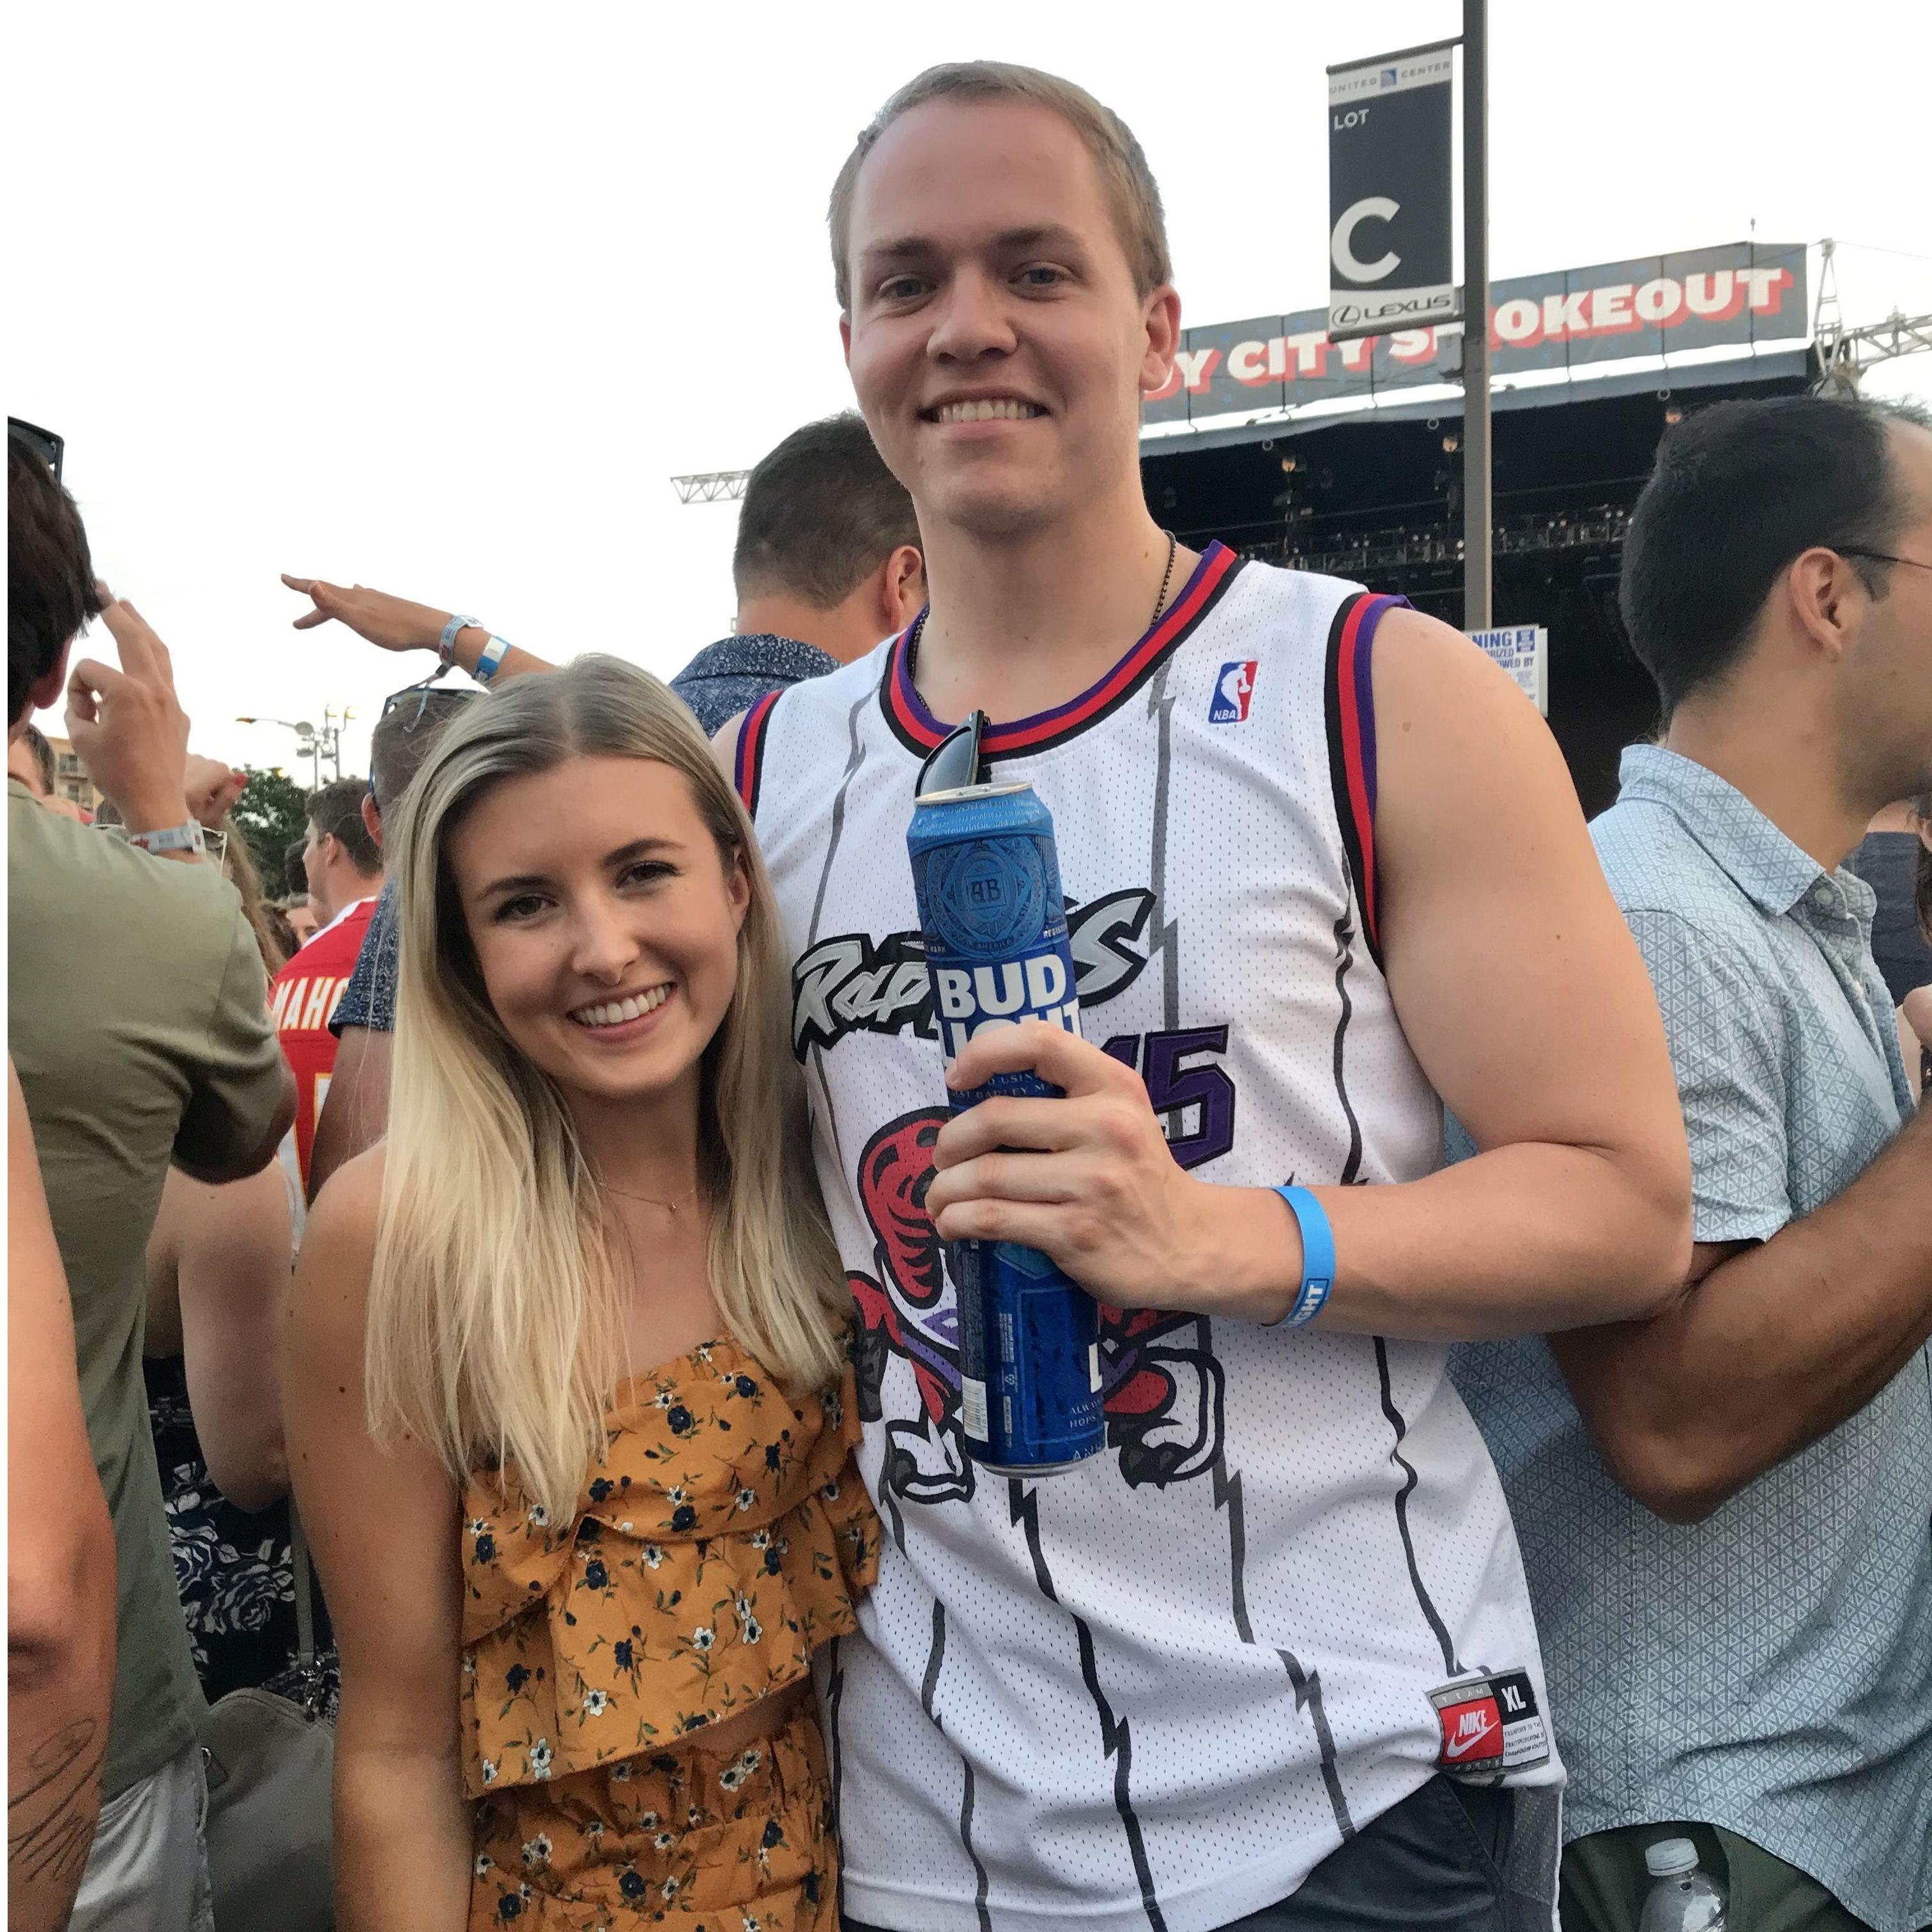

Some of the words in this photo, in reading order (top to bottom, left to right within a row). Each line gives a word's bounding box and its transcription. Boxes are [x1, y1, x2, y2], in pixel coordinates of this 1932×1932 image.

[1329, 77, 1377, 95] UNITED
[1401, 61, 1450, 79] CENTER
[1334, 109, 1369, 130] LOT
[1331, 196, 1402, 283] C
[1364, 294, 1451, 319] LEXUS
[1227, 329, 1366, 380] CITY
[1389, 268, 1782, 356] SOKEOUT
[1524, 657, 1534, 667] BY
[1213, 709, 1236, 721] NBA
[936, 954, 1067, 1019] BUD
[936, 998, 1084, 1070] LIT
[1501, 1685, 1527, 1713] XL
[1459, 1709, 1489, 1738] NIKE
